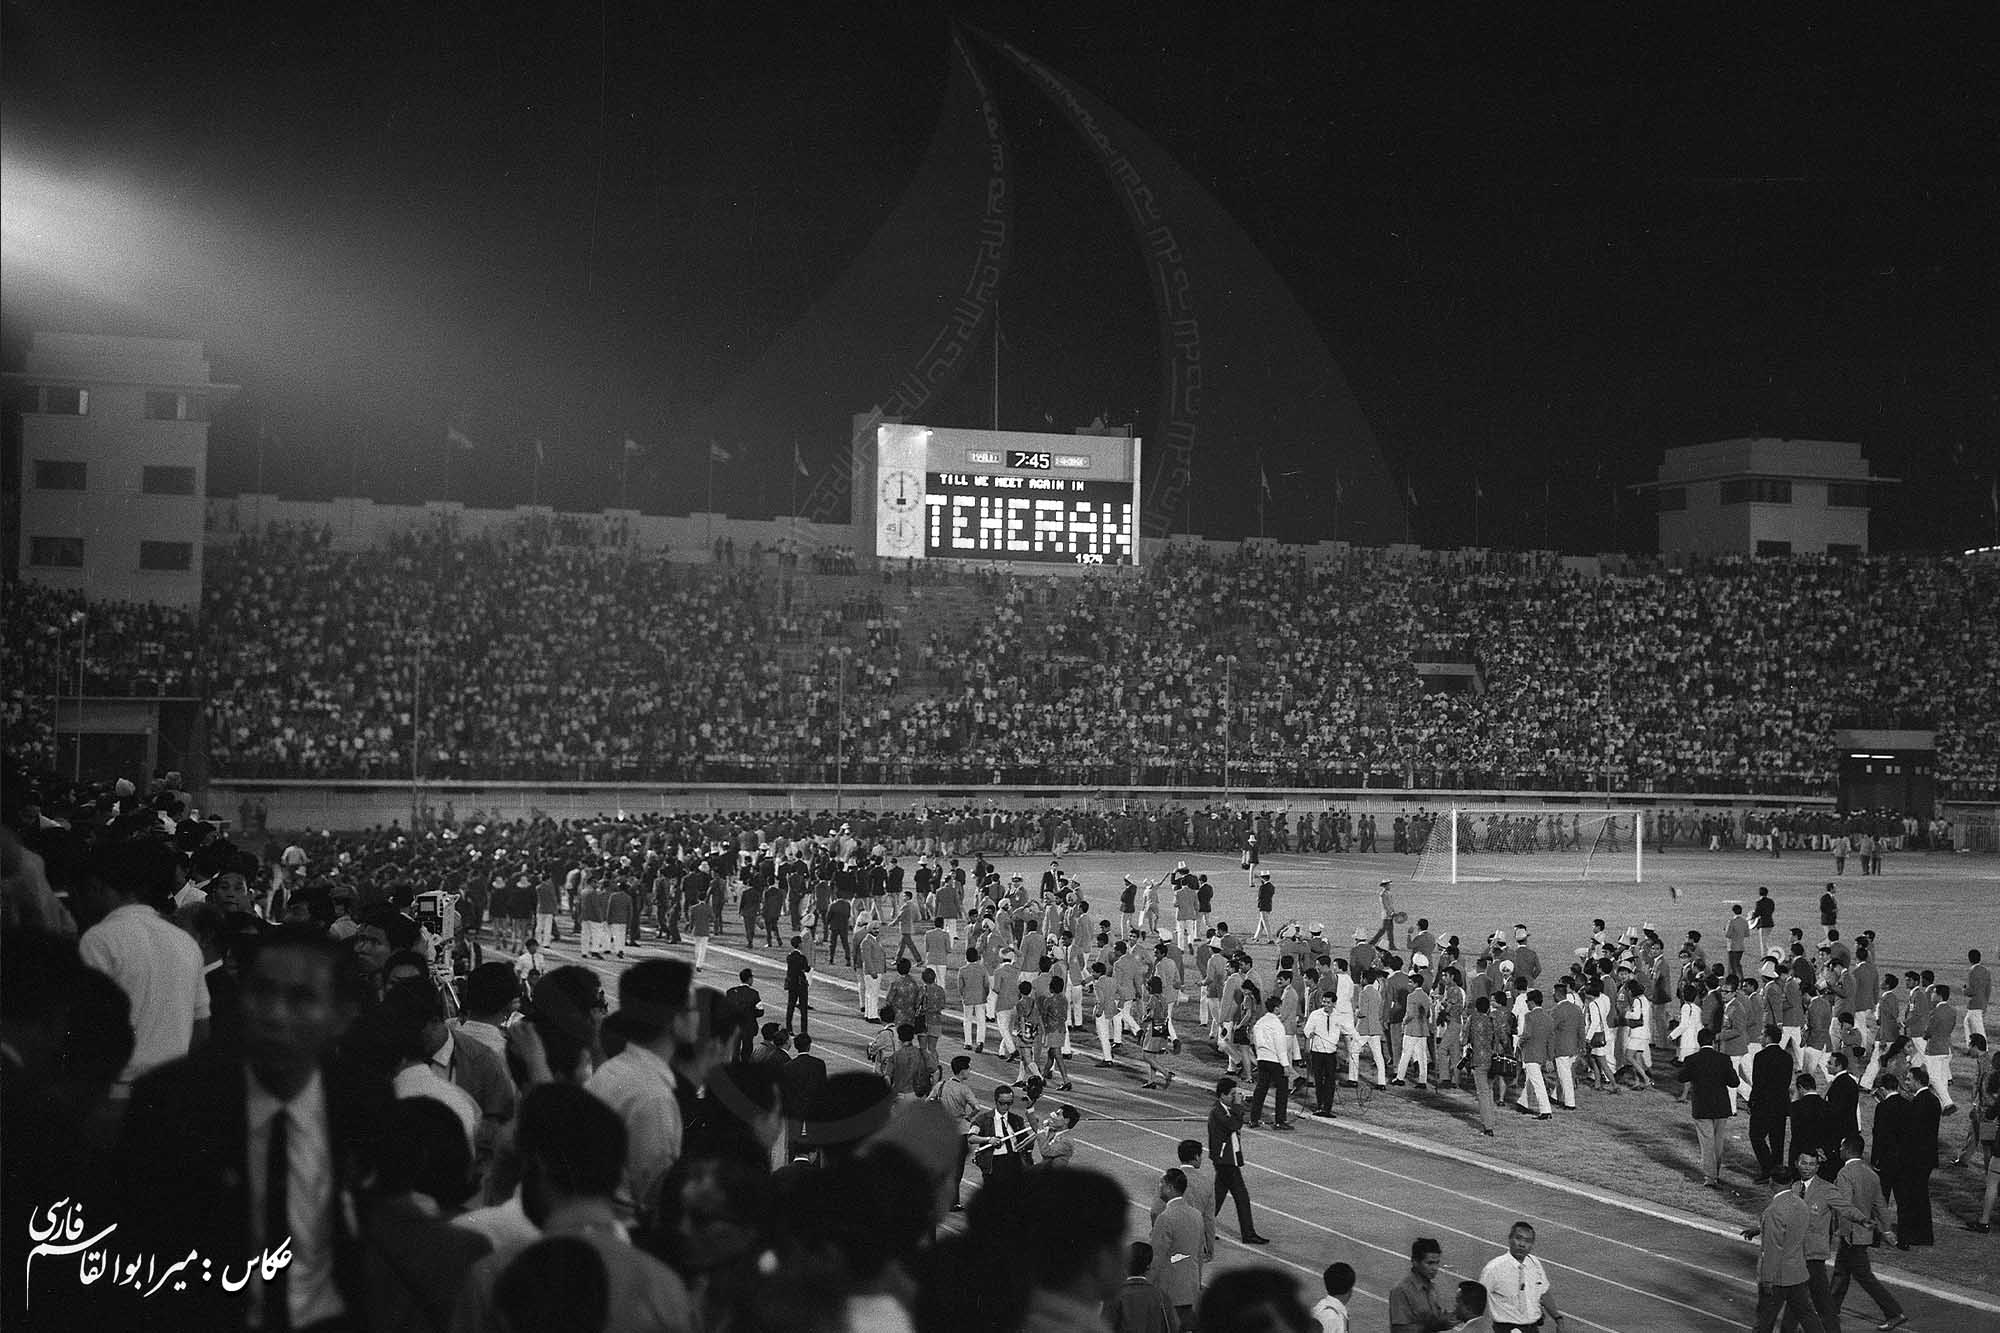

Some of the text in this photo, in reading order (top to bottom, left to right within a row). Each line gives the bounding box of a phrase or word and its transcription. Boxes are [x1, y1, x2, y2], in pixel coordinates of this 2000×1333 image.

[1014, 452, 1051, 469] 7:45
[939, 473, 1085, 491] TILL WE MEET AGAIN IN
[925, 494, 1132, 555] TEHERAN
